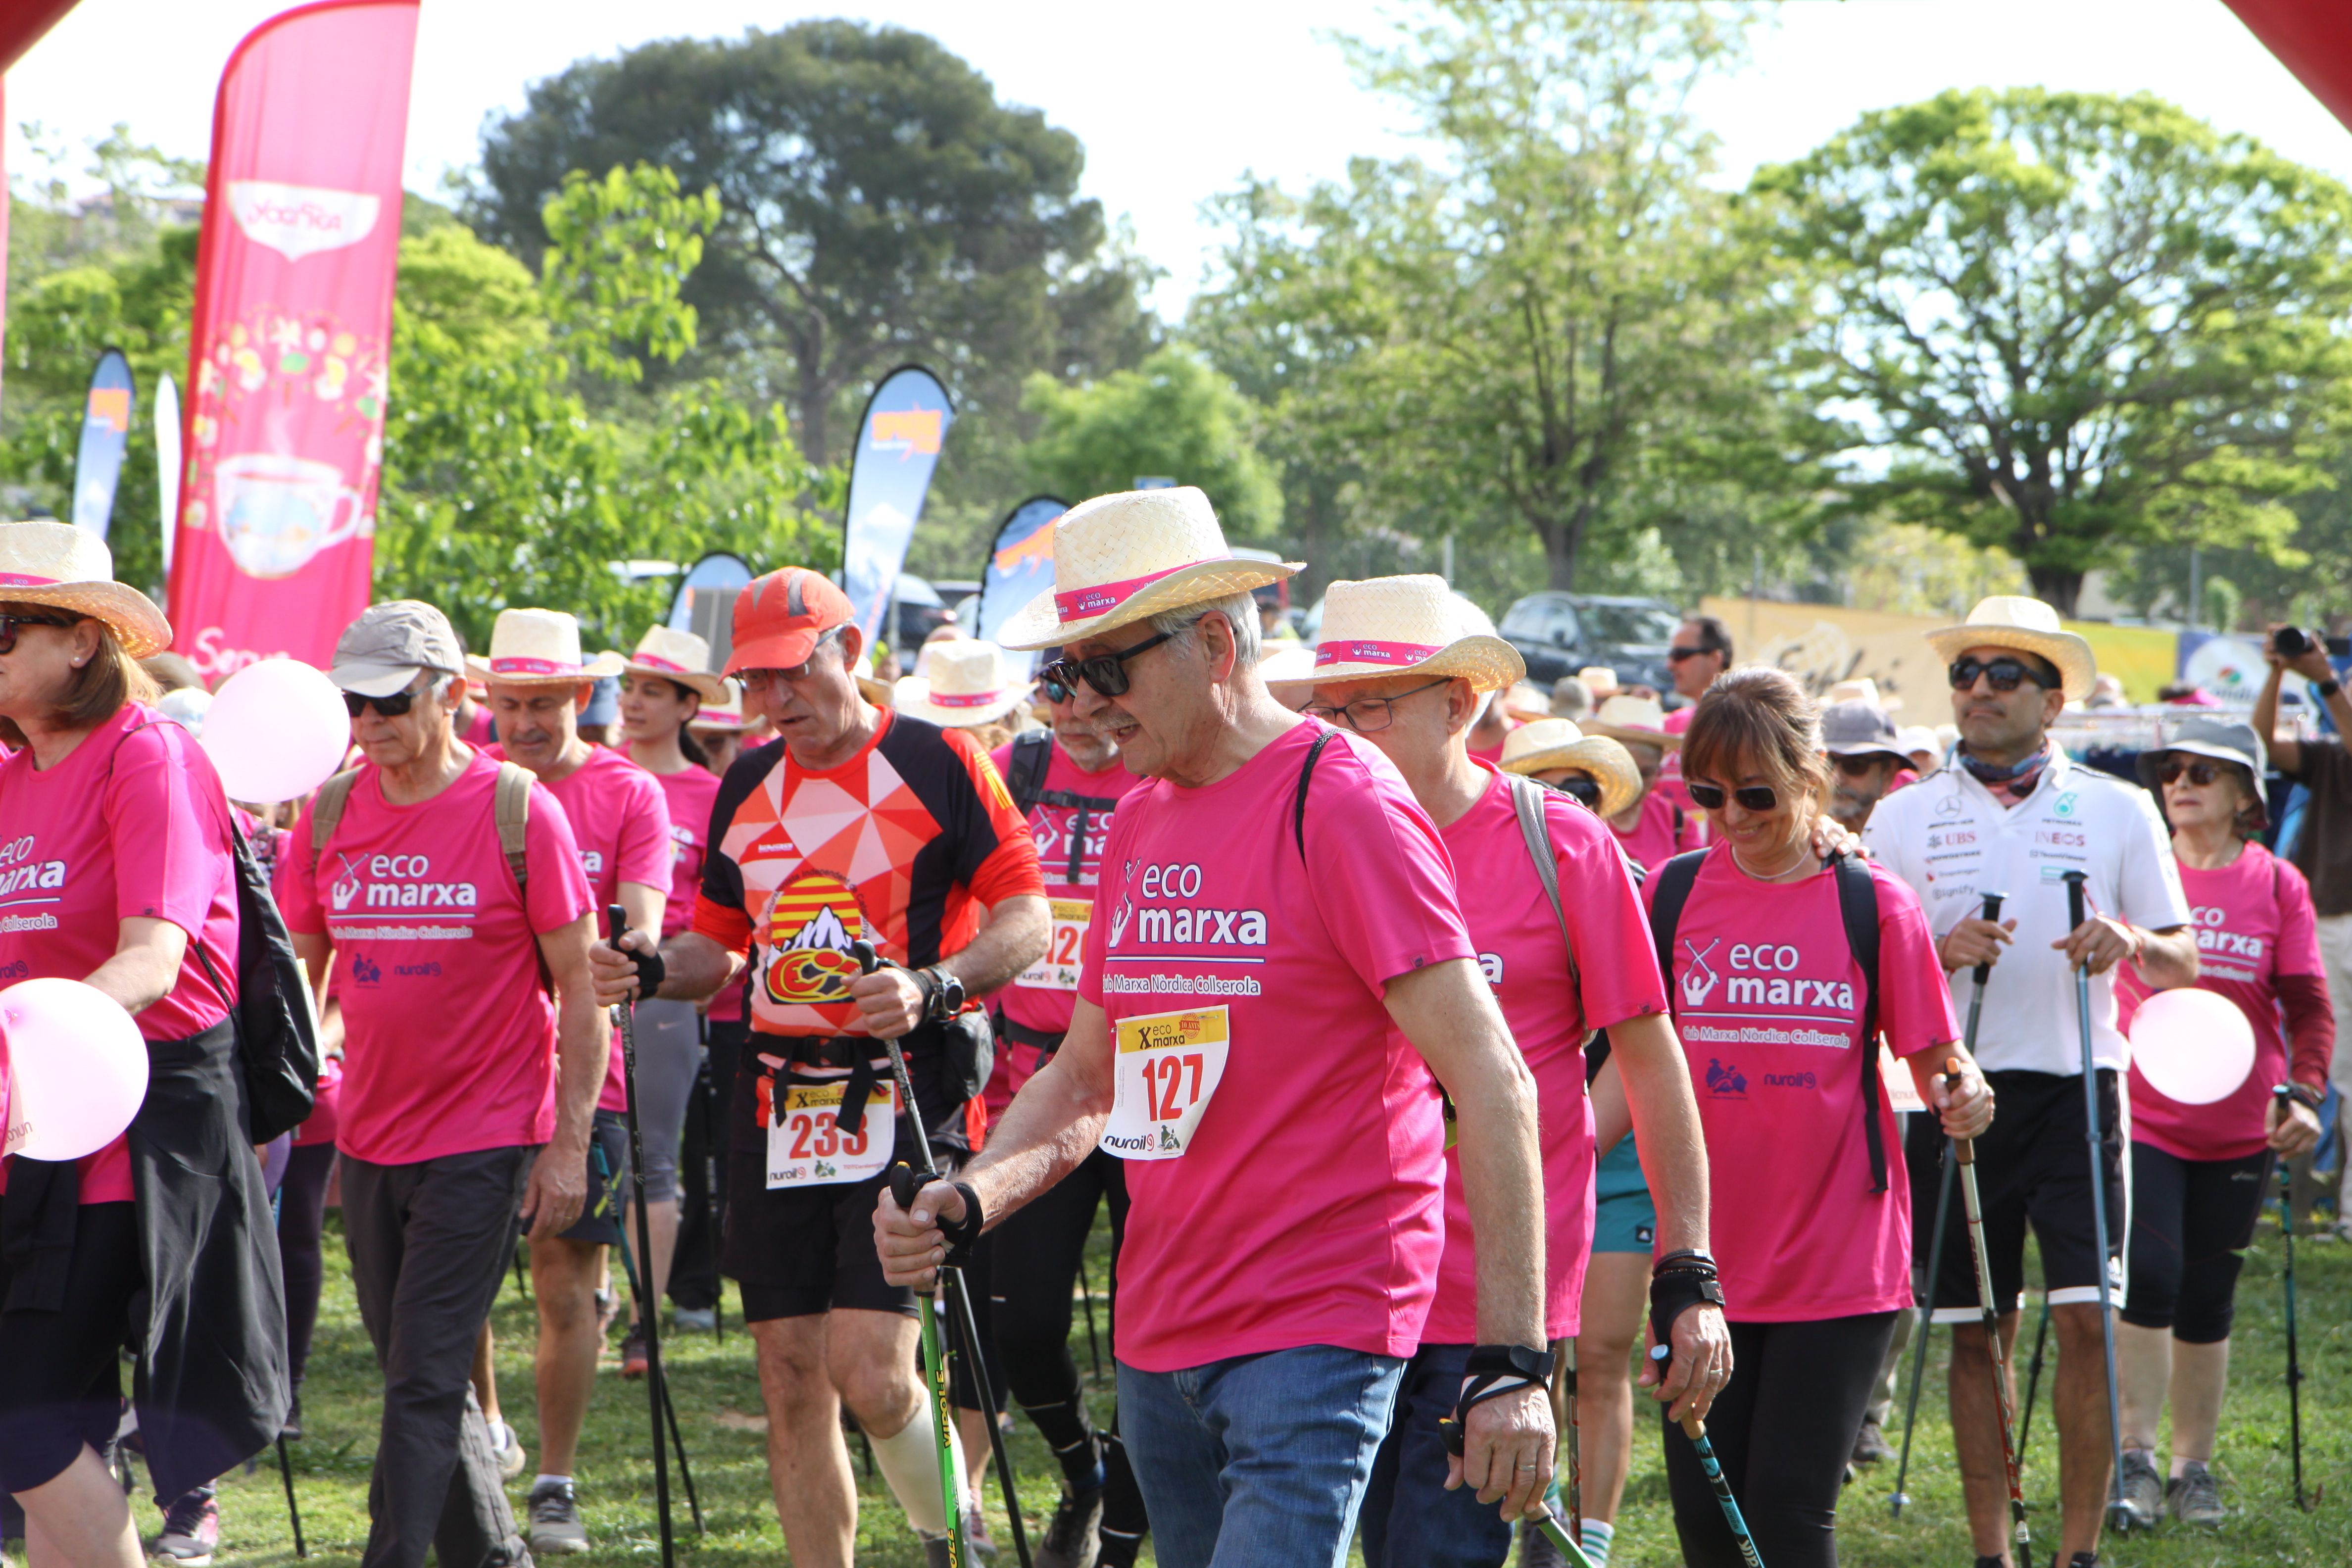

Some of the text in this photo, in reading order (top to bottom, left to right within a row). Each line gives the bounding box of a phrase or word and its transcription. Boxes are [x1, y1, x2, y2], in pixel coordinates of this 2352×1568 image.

[1087, 596, 1116, 608] marxa
[1945, 831, 1976, 845] UBS
[2035, 831, 2085, 847] INEOS
[0, 835, 34, 866] eco
[370, 854, 429, 878] eco
[1141, 864, 1202, 898] eco
[366, 882, 477, 907] marxa
[3, 914, 56, 930] Collserola
[1139, 909, 1266, 944] marxa
[2191, 906, 2225, 927] co
[1729, 943, 1799, 972] eco
[1115, 976, 1149, 991] Marxa
[1152, 975, 1193, 991] Nòrdica
[1195, 975, 1259, 993] Collserola
[1727, 977, 1854, 1010] marxa
[1138, 1026, 1185, 1049] X marxa
[1153, 1024, 1172, 1035] eco
[1702, 1028, 1738, 1040] Marxa
[1741, 1028, 1789, 1041] Nòrdica
[1792, 1030, 1849, 1047] Collserola
[1142, 1053, 1203, 1121] 127
[796, 1091, 809, 1108] X
[789, 1112, 868, 1159] 233
[935, 1370, 951, 1449] VIPOLE
